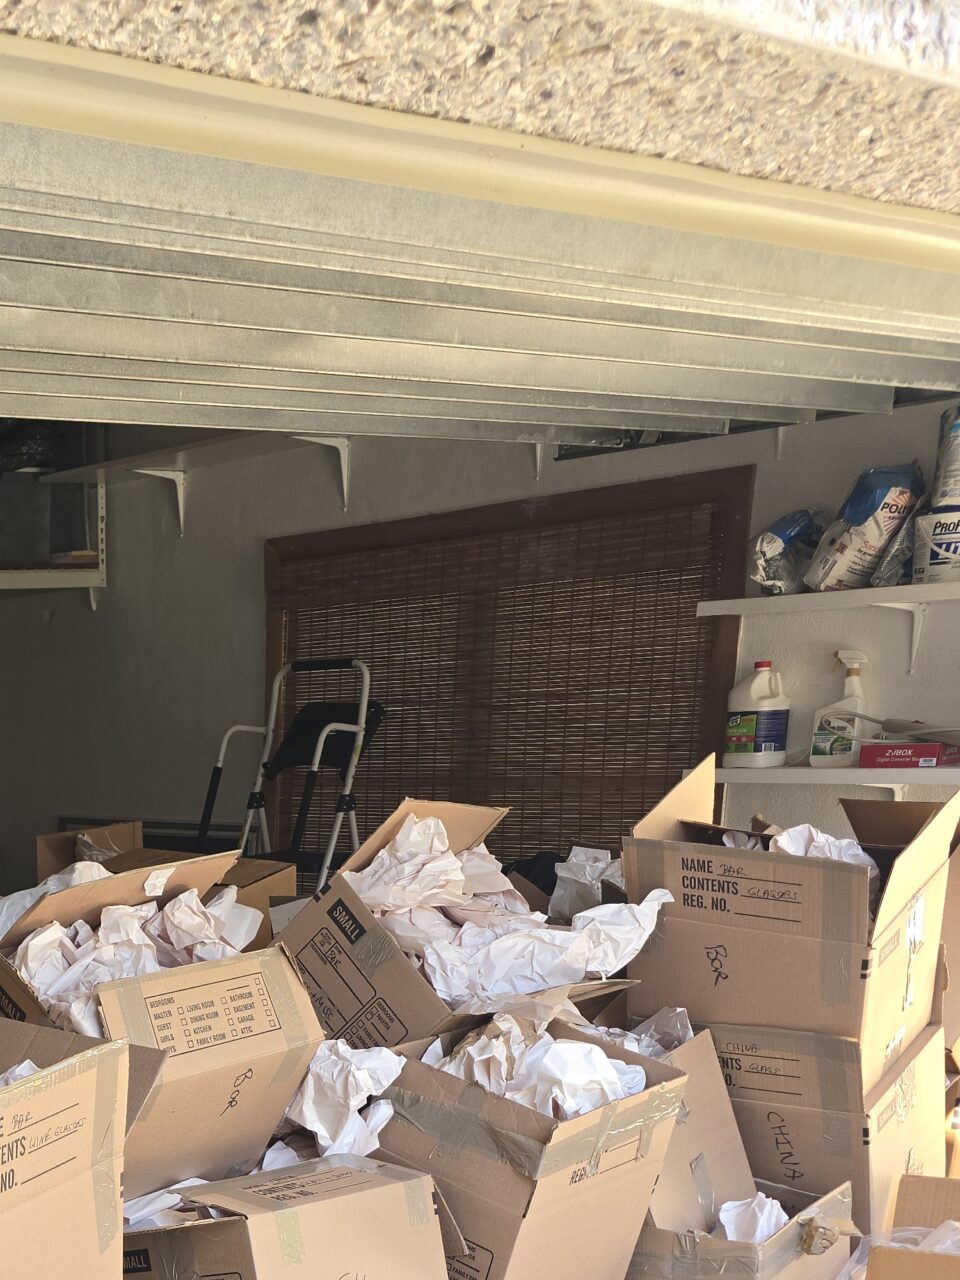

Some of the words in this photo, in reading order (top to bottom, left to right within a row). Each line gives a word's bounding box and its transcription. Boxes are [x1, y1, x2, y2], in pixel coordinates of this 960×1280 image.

[681, 858, 713, 874] NAME
[682, 876, 738, 895] CONTENTS
[683, 893, 707, 909] REG.
[711, 896, 730, 912] NO.
[333, 906, 358, 941] SMALL
[0, 1168, 17, 1193] NO.
[123, 1255, 147, 1269] MALL
